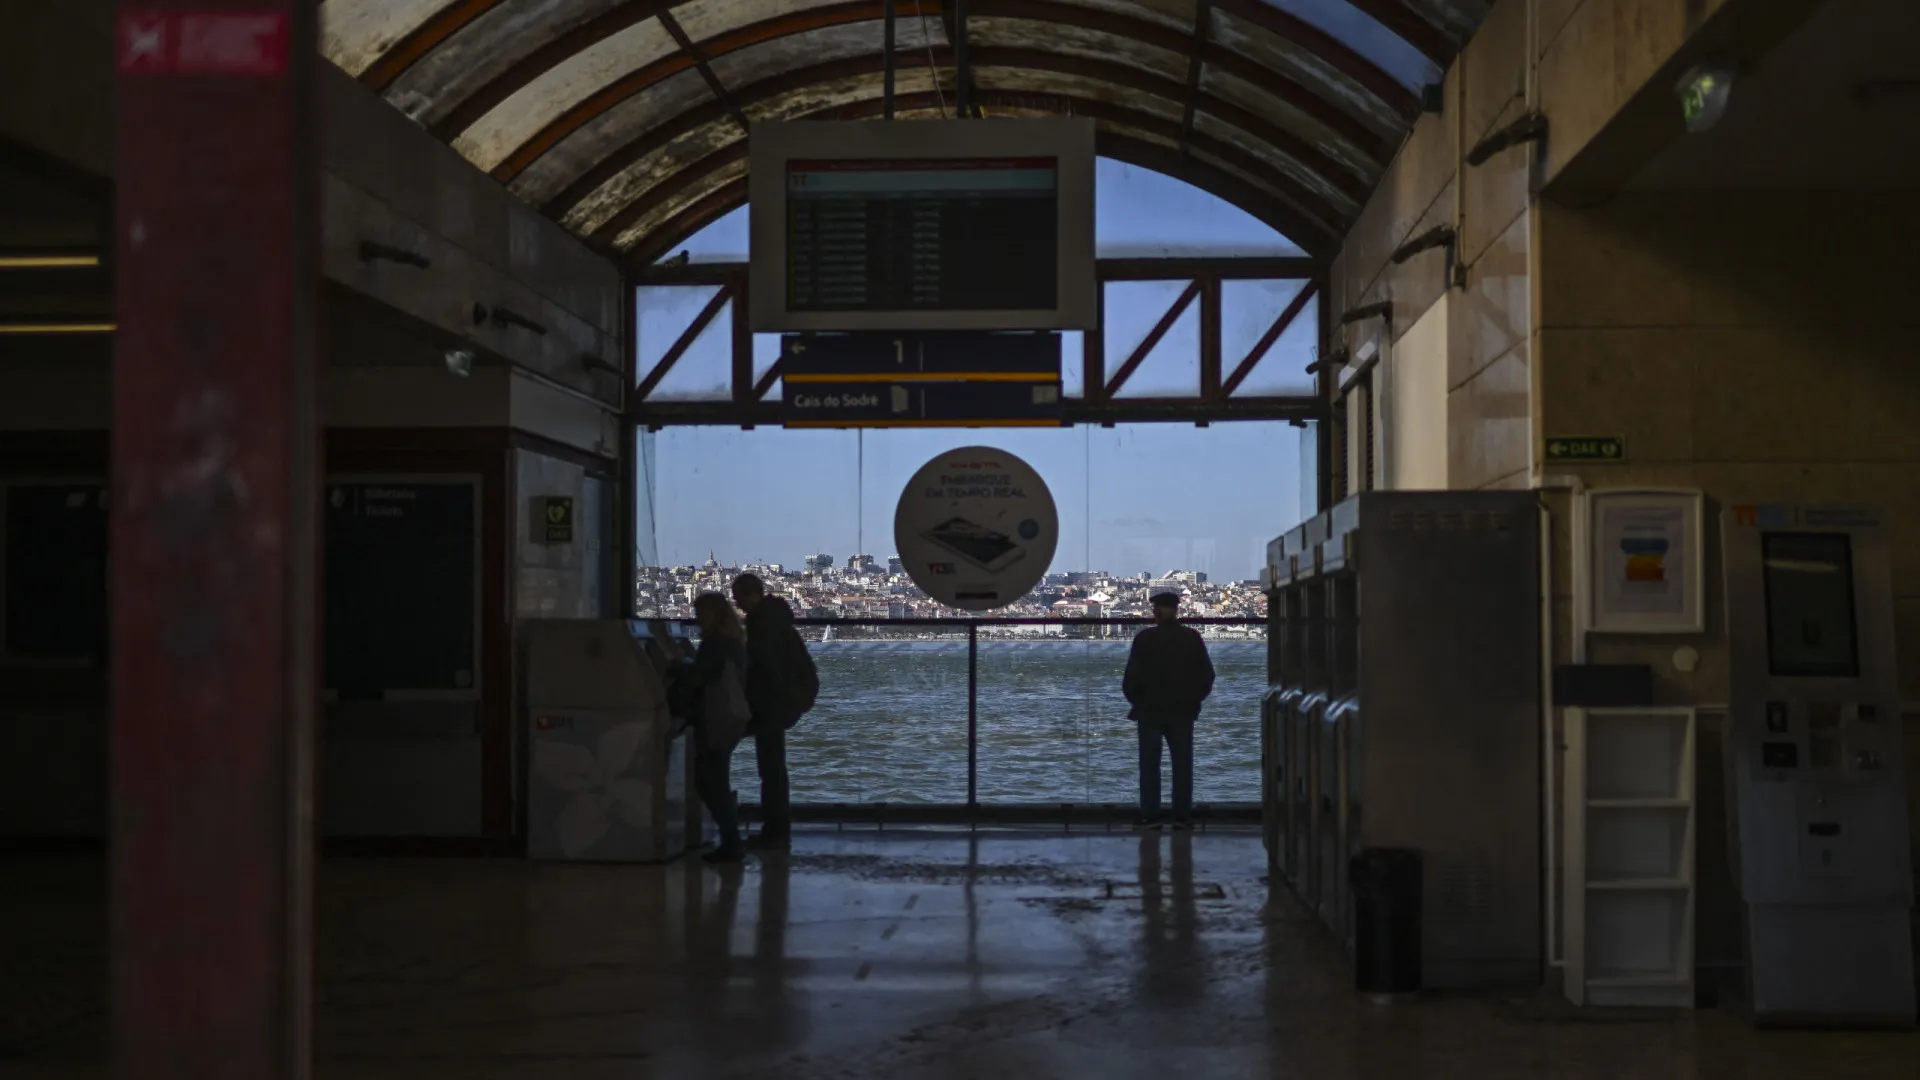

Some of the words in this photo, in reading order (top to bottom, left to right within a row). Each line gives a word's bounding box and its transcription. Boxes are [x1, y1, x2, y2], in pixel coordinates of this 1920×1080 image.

[892, 338, 904, 364] 1
[794, 393, 820, 408] Cais
[823, 393, 840, 408] do
[842, 392, 880, 408] Sodré
[1570, 441, 1599, 454] DAE
[940, 473, 1012, 486] EMBARQUE
[925, 487, 944, 498] EM
[947, 487, 992, 498] TEMPO
[994, 486, 1027, 497] REAL
